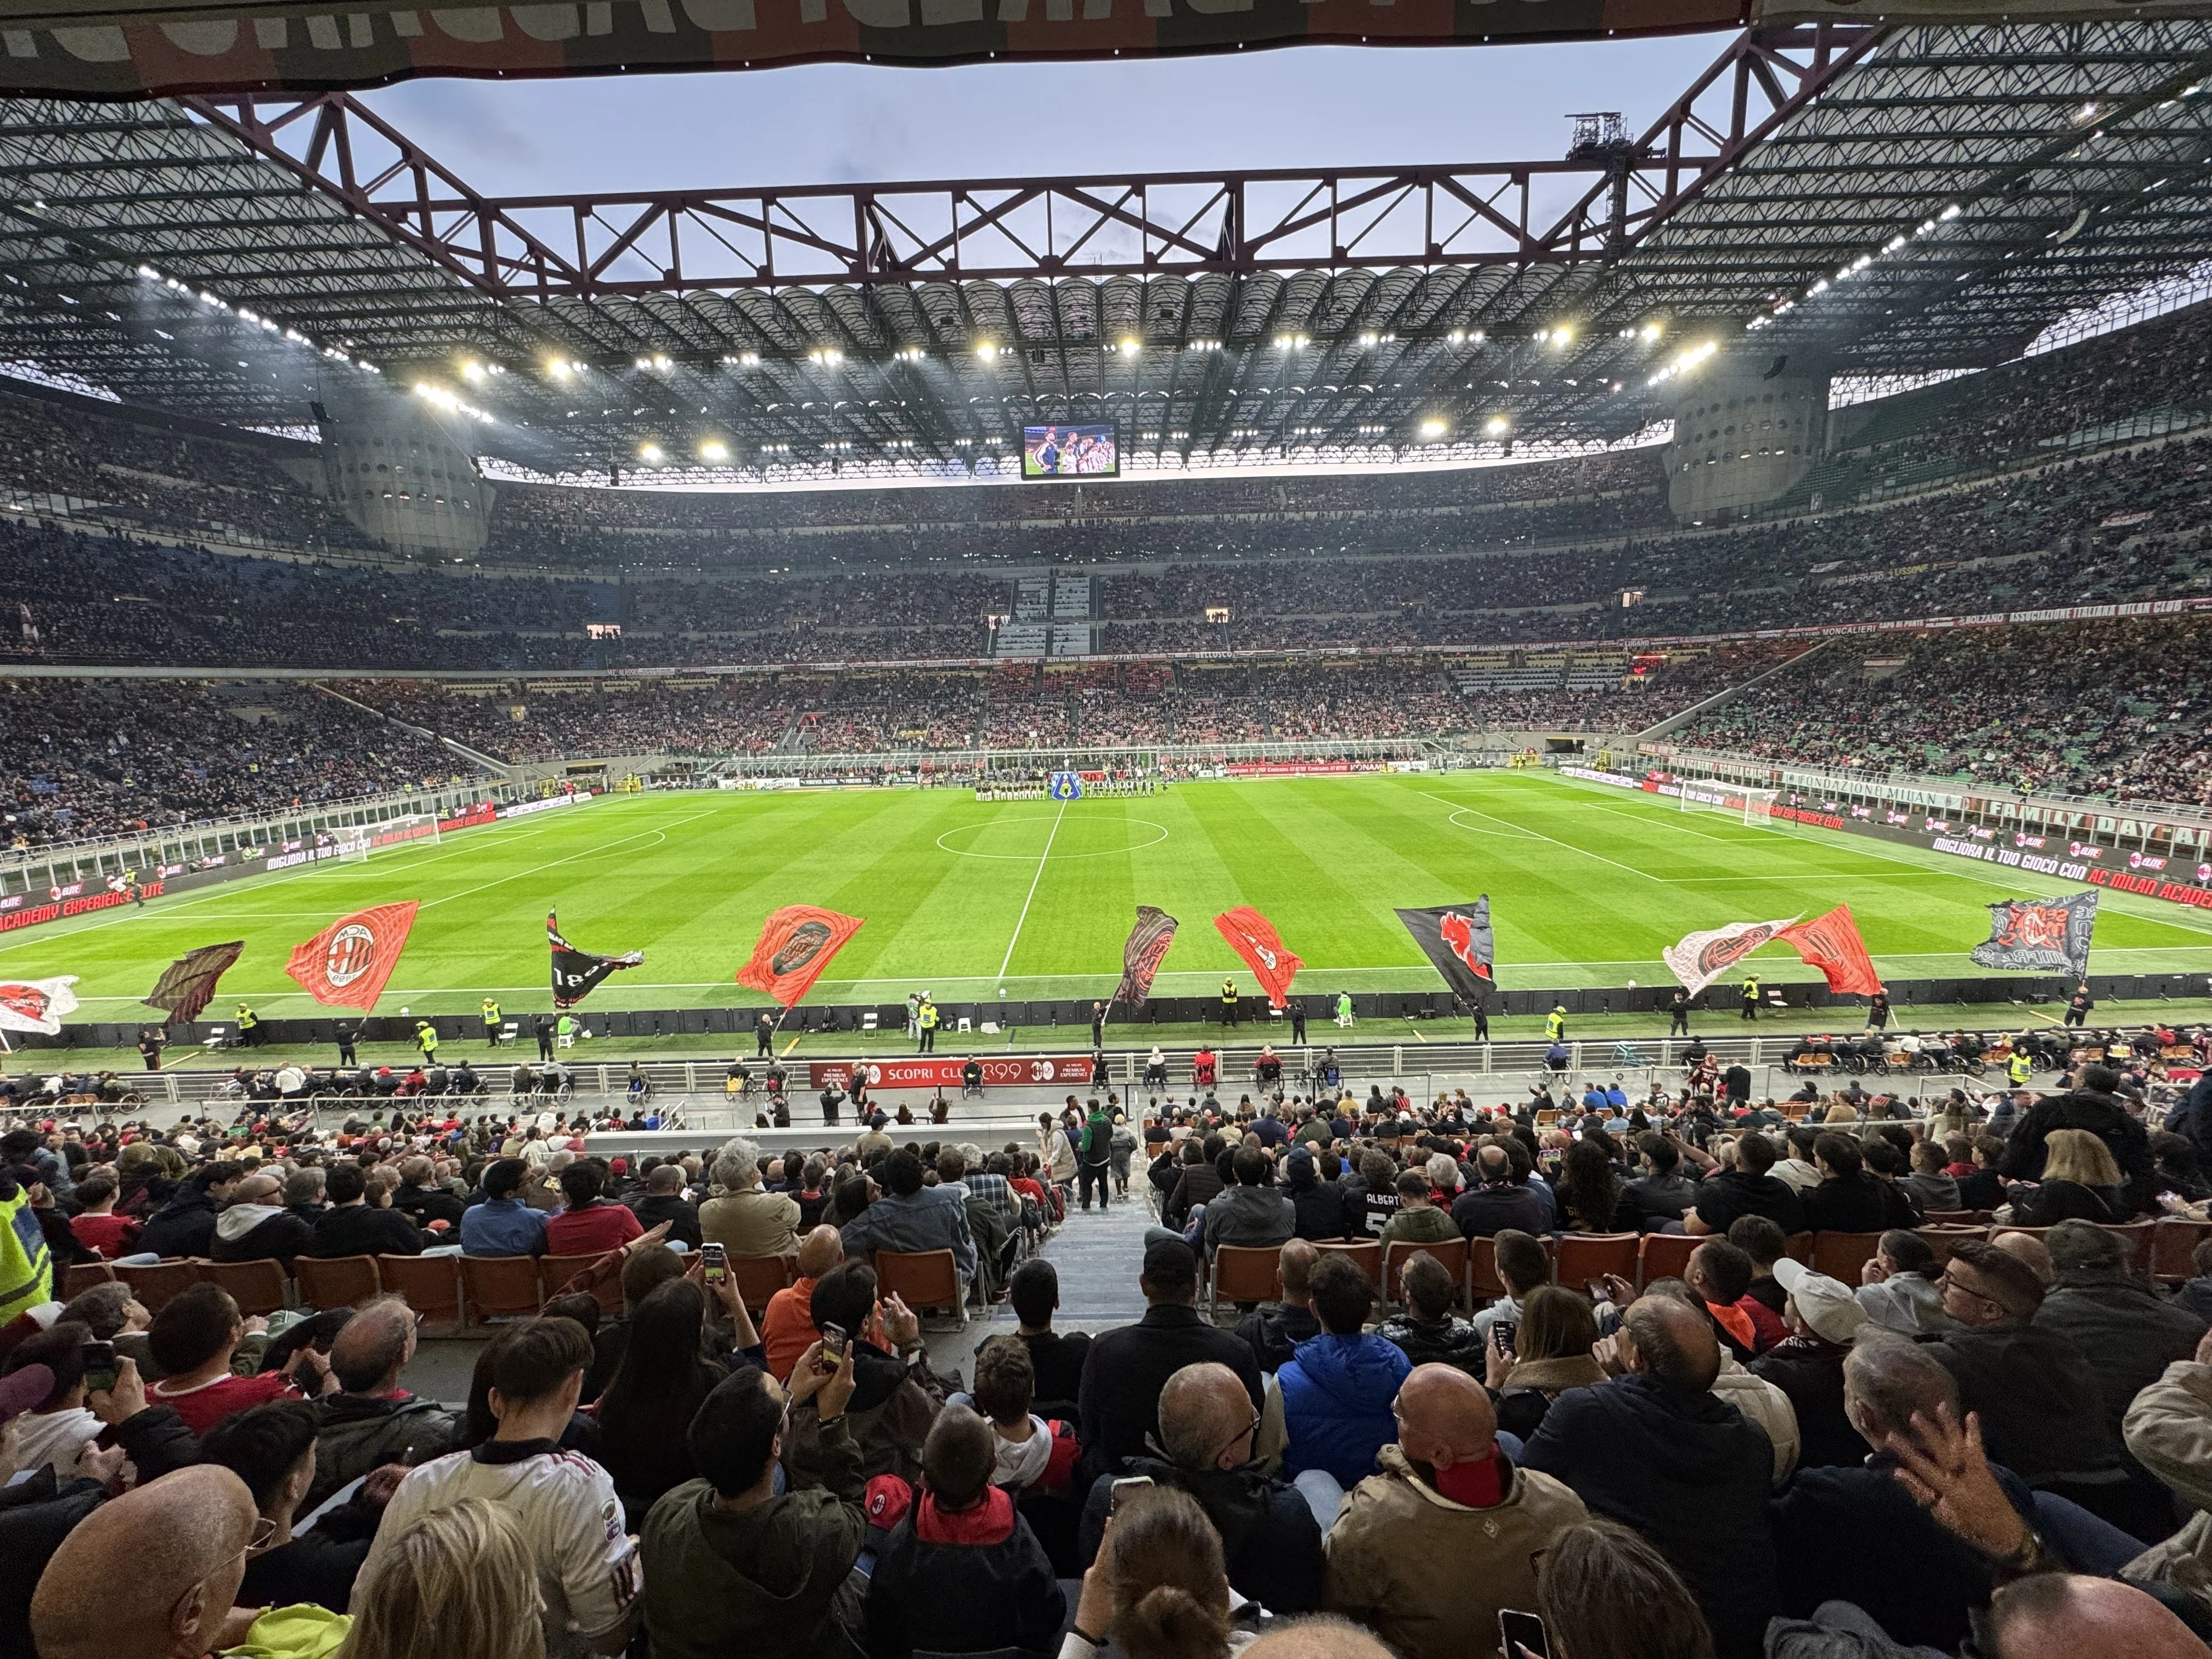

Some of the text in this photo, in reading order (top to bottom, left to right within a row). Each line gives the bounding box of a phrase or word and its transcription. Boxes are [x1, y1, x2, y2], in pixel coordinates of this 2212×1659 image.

[2009, 609, 2070, 622] ASSOCIAZIONE
[2073, 605, 2115, 619] ITALIANA
[2118, 602, 2150, 616] MILAN
[2153, 600, 2183, 613] CLUB
[1966, 613, 2004, 624] BOLZANO
[1822, 625, 1876, 636] MONCALIERI
[1745, 766, 1770, 778] CALCIO
[1799, 775, 1936, 805] FONDAZIONE MILAN
[1990, 802, 2084, 827] FAMILY
[2097, 816, 2158, 840] DAY
[267, 850, 306, 871] MIGLIORA
[308, 849, 316, 861] IL
[317, 845, 332, 859] TUO
[334, 840, 356, 856] GIOCO
[433, 817, 464, 833] EPERIENCE
[2025, 837, 2044, 848] ELITE
[2080, 847, 2100, 857] ELITE
[1932, 837, 1984, 859] MIGLIORA
[1984, 847, 1995, 861] IL
[1997, 849, 2022, 866] TUO
[2021, 855, 2058, 874] GIOCO
[2058, 862, 2087, 880] CON
[2087, 868, 2109, 885] AC
[2109, 872, 2159, 895] MILAN
[2141, 857, 2164, 869] ELITE
[62, 884, 81, 896] ELITE
[139, 881, 165, 900] LITE
[1, 895, 21, 908] ELITE
[888, 1063, 1022, 1080] SCOPRI CLU 899
